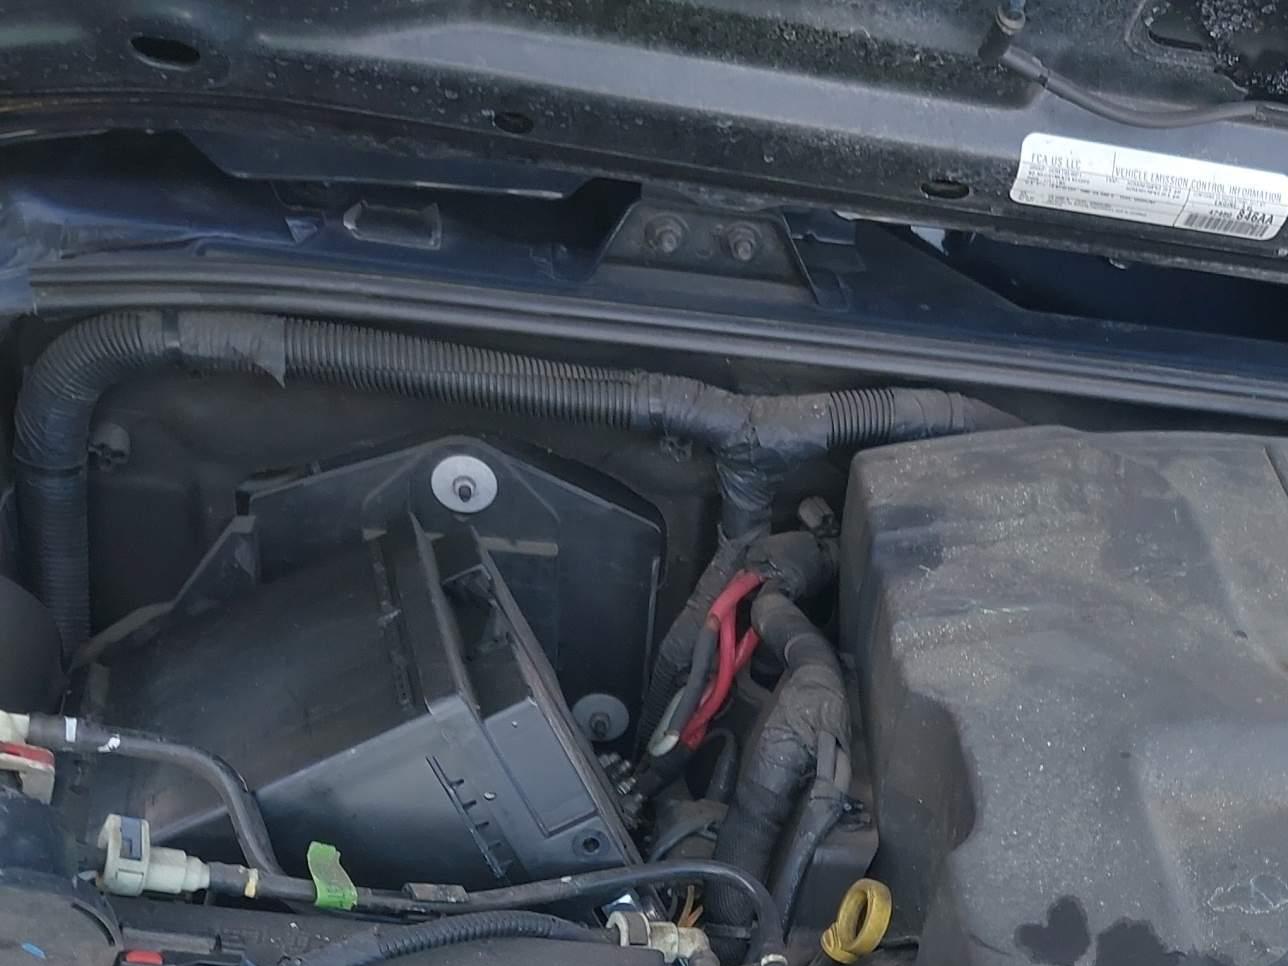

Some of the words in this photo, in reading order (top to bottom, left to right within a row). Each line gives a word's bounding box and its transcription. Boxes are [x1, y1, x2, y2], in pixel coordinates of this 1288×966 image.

[1115, 167, 1148, 183] VEHICLE
[1150, 171, 1189, 188] EMISSION
[1191, 178, 1225, 194] CONTROL
[1228, 183, 1282, 202] INFORMATION
